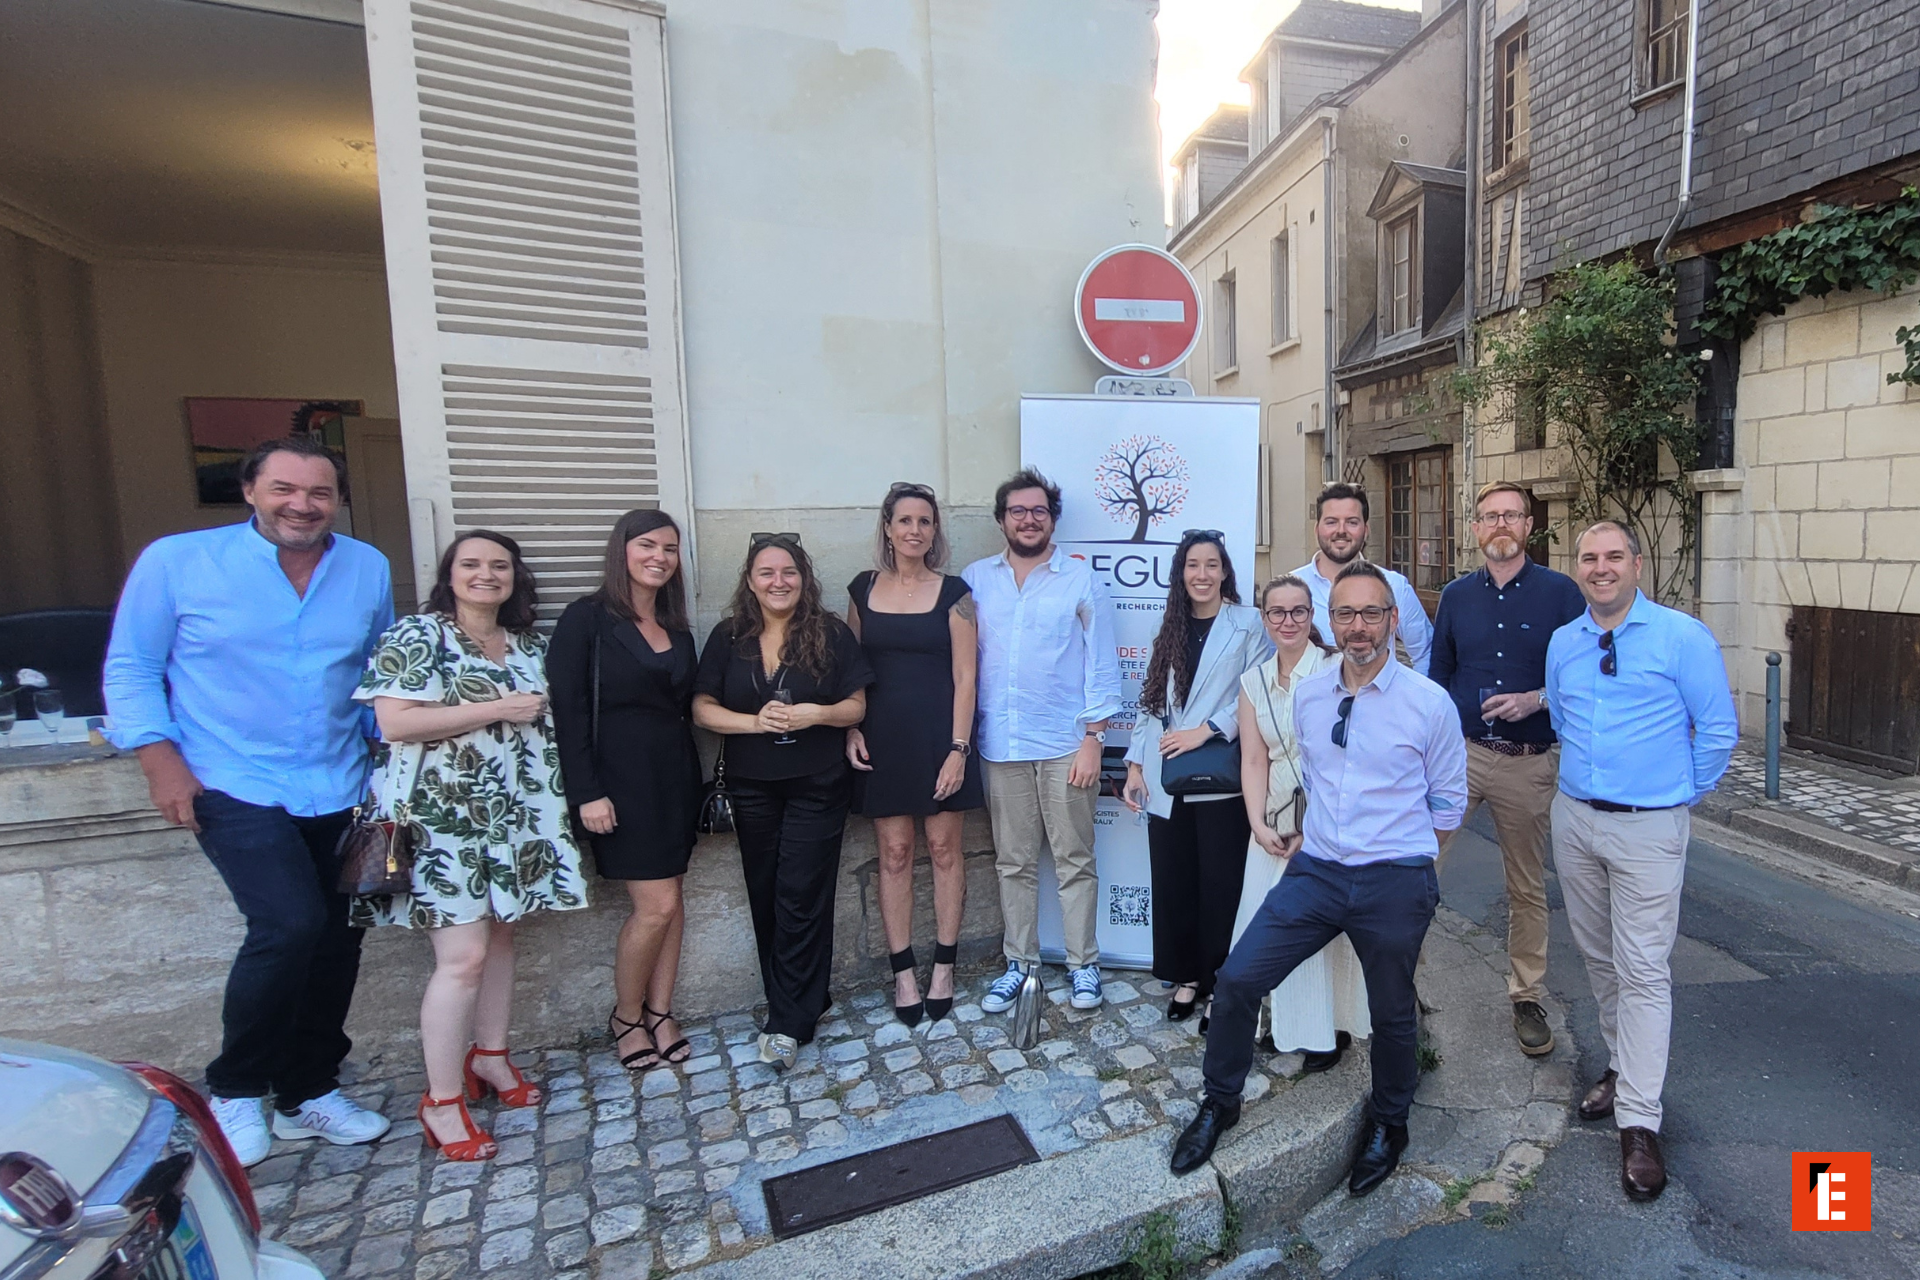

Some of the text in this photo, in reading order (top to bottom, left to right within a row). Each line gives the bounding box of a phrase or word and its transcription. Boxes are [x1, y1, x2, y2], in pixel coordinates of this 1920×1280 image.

[1069, 553, 1171, 588] EGU
[1116, 602, 1166, 611] RECHERCH
[1118, 659, 1138, 669] ÊTE
[301, 1111, 331, 1131] N
